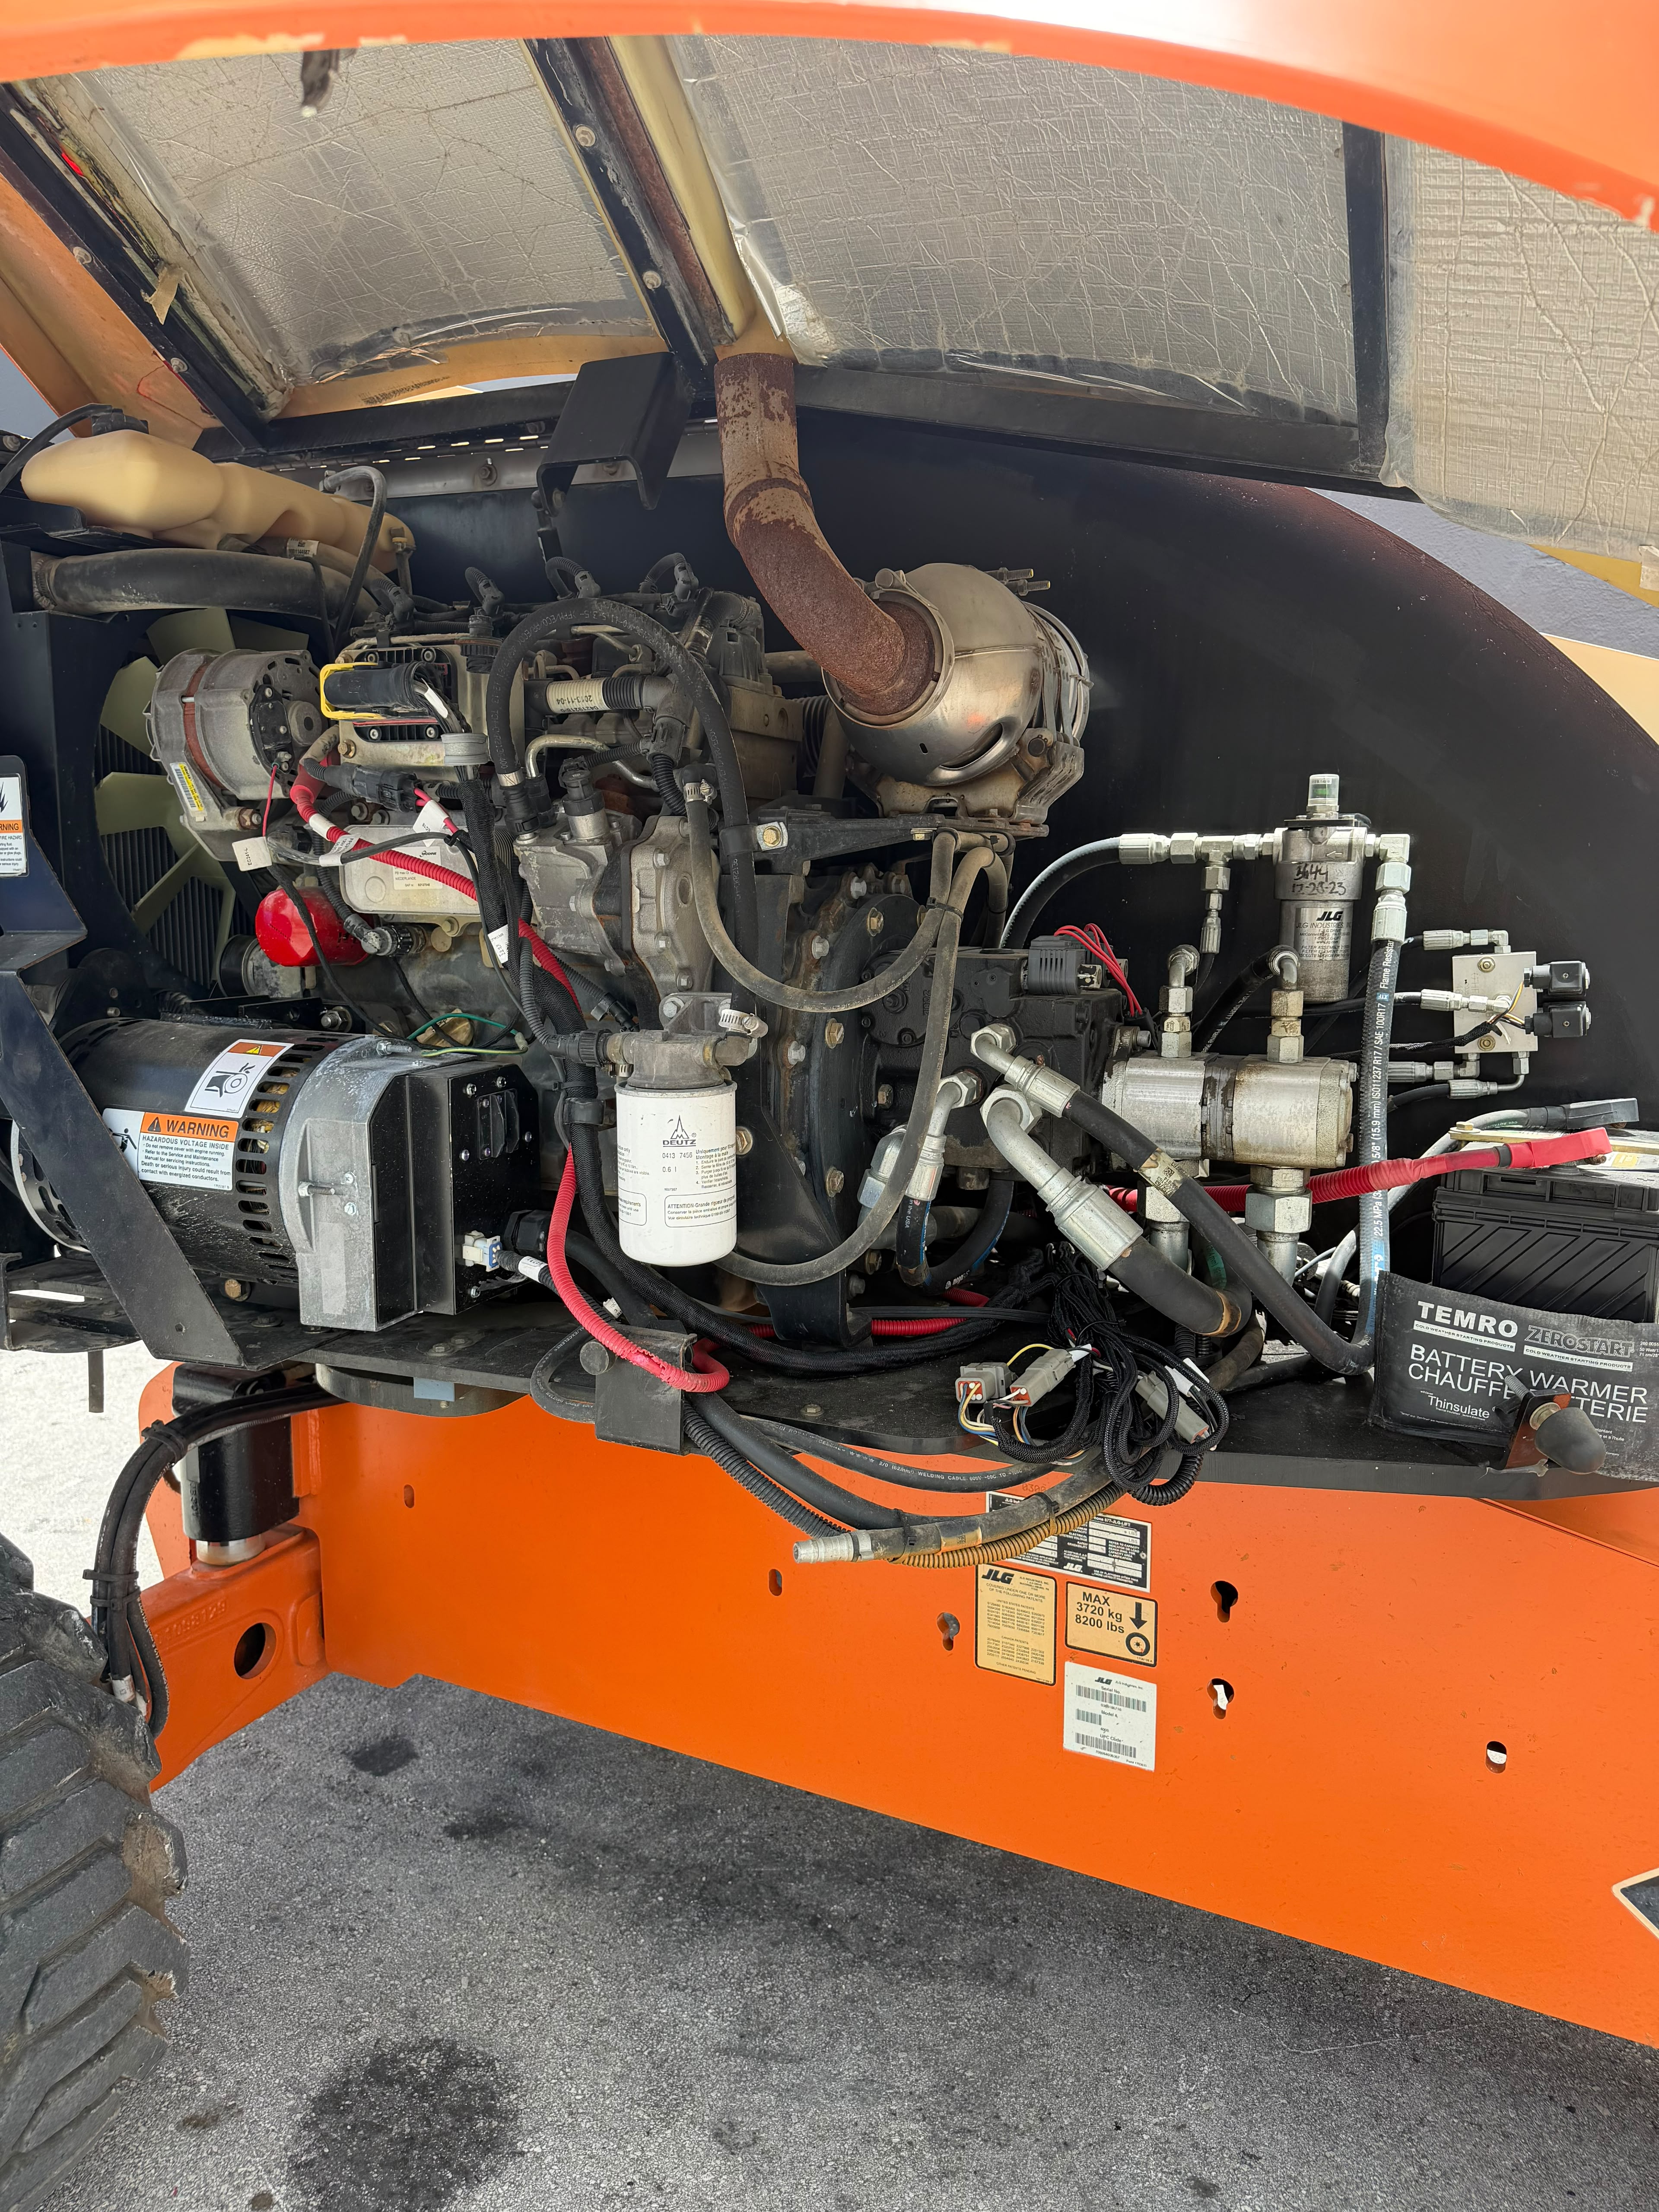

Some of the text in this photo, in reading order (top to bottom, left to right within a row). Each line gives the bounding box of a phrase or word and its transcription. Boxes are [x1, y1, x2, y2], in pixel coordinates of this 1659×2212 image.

[556, 695, 592, 705] 2013-11-04
[1316, 911, 1343, 921] JLG
[1379, 968, 1390, 989] Flame
[1376, 1003, 1386, 1029] 100R17
[1374, 1031, 1384, 1045] SAE
[1373, 1052, 1382, 1065] R17
[1371, 1101, 1382, 1118] mm)
[167, 1119, 229, 1138] WARNING
[1371, 1120, 1382, 1141] (15.9
[143, 1135, 178, 1144] HAZARDOUS
[180, 1139, 207, 1148] VOLTAGE
[1373, 1201, 1382, 1237] 22.5 MPa
[1417, 1301, 1518, 1338] TEMRO
[1430, 1327, 1456, 1336] WEATHER
[1456, 1333, 1483, 1342] STARTING
[1484, 1340, 1513, 1348] PRODUCTS
[1524, 1325, 1635, 1357] ZEROSTART
[1542, 1351, 1570, 1361] WEATHER
[1570, 1357, 1599, 1365] STARTING
[1411, 1344, 1647, 1404] BATTERY WARMER
[1428, 1395, 1490, 1418] Thinsulate
[918, 1471, 944, 1479] WELDING
[1104, 1517, 1130, 1527] 877-JLG-LIFT
[1063, 1562, 1083, 1572] JLG
[982, 1569, 1014, 1584] JLG
[1083, 1592, 1110, 1606] MAX
[1077, 1602, 1122, 1623] 3720 kg
[1075, 1614, 1125, 1634] 8200 lbs
[1095, 1677, 1112, 1685] JLG
